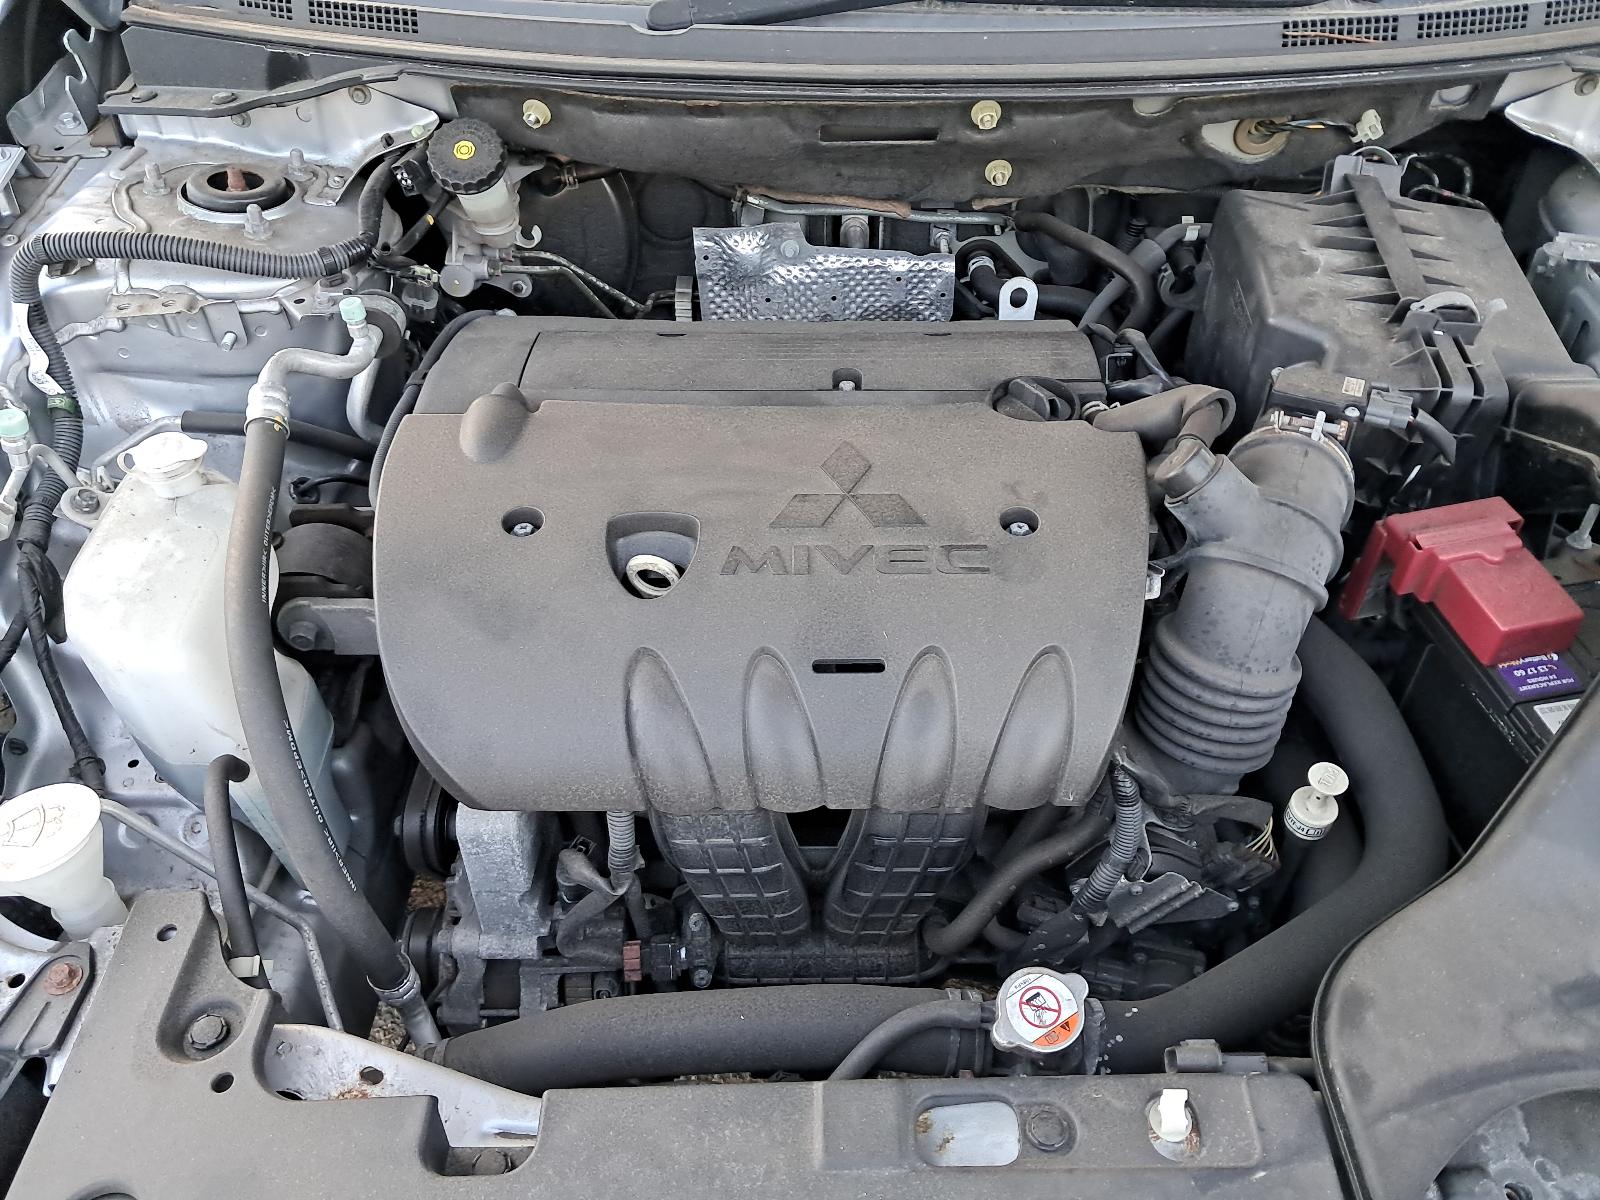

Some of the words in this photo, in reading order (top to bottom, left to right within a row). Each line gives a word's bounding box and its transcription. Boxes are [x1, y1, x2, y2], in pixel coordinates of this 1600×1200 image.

[720, 545, 990, 575] MIVEC
[1527, 666, 1537, 675] 17
[1537, 664, 1548, 672] 13
[1513, 669, 1526, 677] 60
[1526, 675, 1549, 684] HOURS
[1519, 680, 1561, 691] REPLACEMENT
